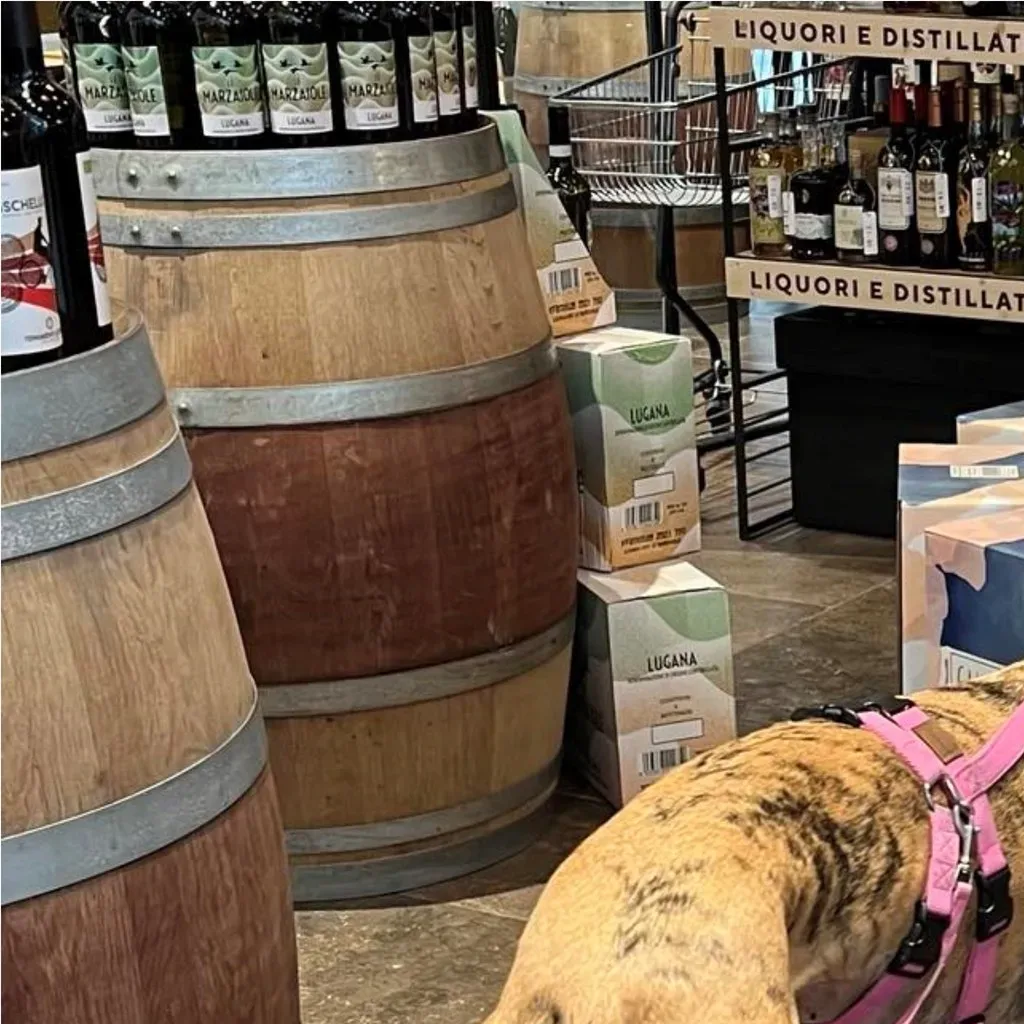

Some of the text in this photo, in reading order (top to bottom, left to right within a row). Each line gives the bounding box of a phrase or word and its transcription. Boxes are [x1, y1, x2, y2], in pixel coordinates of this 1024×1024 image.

[733, 18, 846, 44] LIQUORI
[858, 25, 872, 46] E
[750, 271, 858, 297] LIQUORI
[869, 281, 883, 299] E
[629, 403, 671, 425] LUGANA
[646, 651, 698, 673] LUGANA
